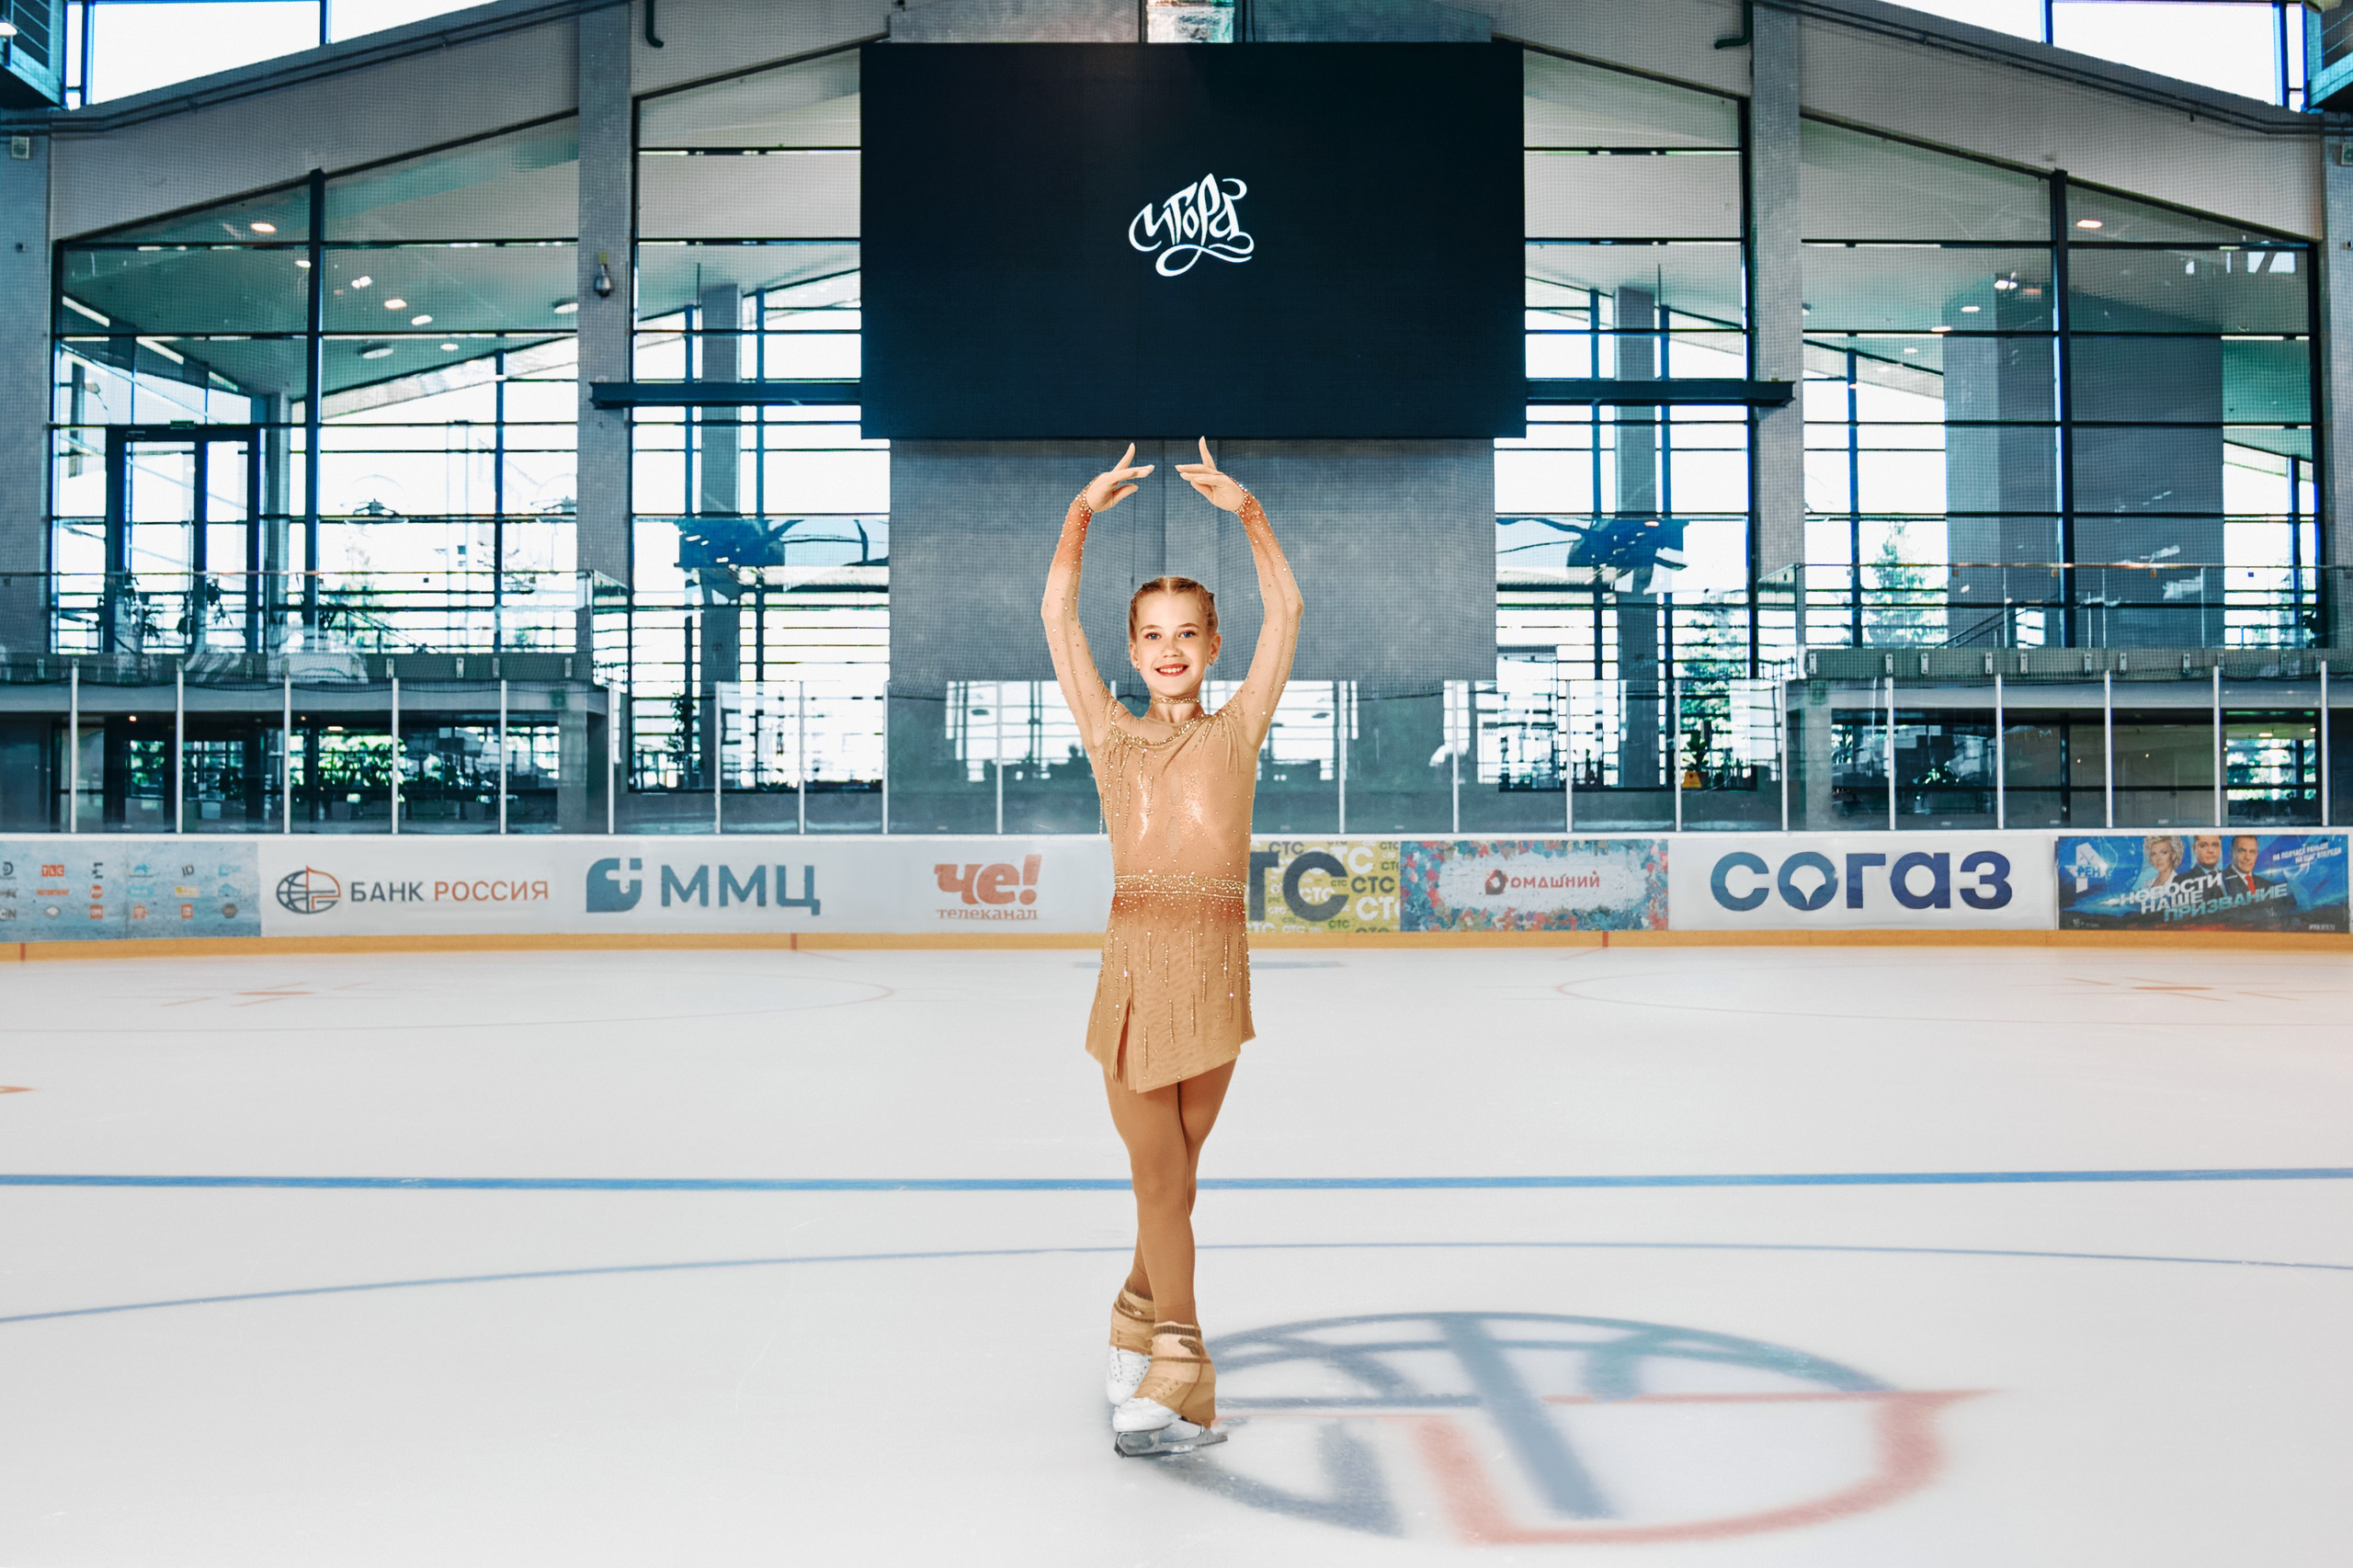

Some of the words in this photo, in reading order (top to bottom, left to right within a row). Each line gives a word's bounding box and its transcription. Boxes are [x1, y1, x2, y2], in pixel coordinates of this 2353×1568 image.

[1268, 841, 1303, 855] СТС
[42, 866, 64, 876] TLC
[350, 881, 425, 903] БАНК
[434, 881, 549, 902] РОССИЯ
[661, 865, 821, 915] ММЦ
[1351, 876, 1396, 893] СТС
[2120, 873, 2222, 905] НОВОСТИ
[2141, 890, 2204, 915] НАШЕ
[2164, 883, 2288, 922] ПРИЗВАНИЕ
[937, 908, 1038, 920] телеканал
